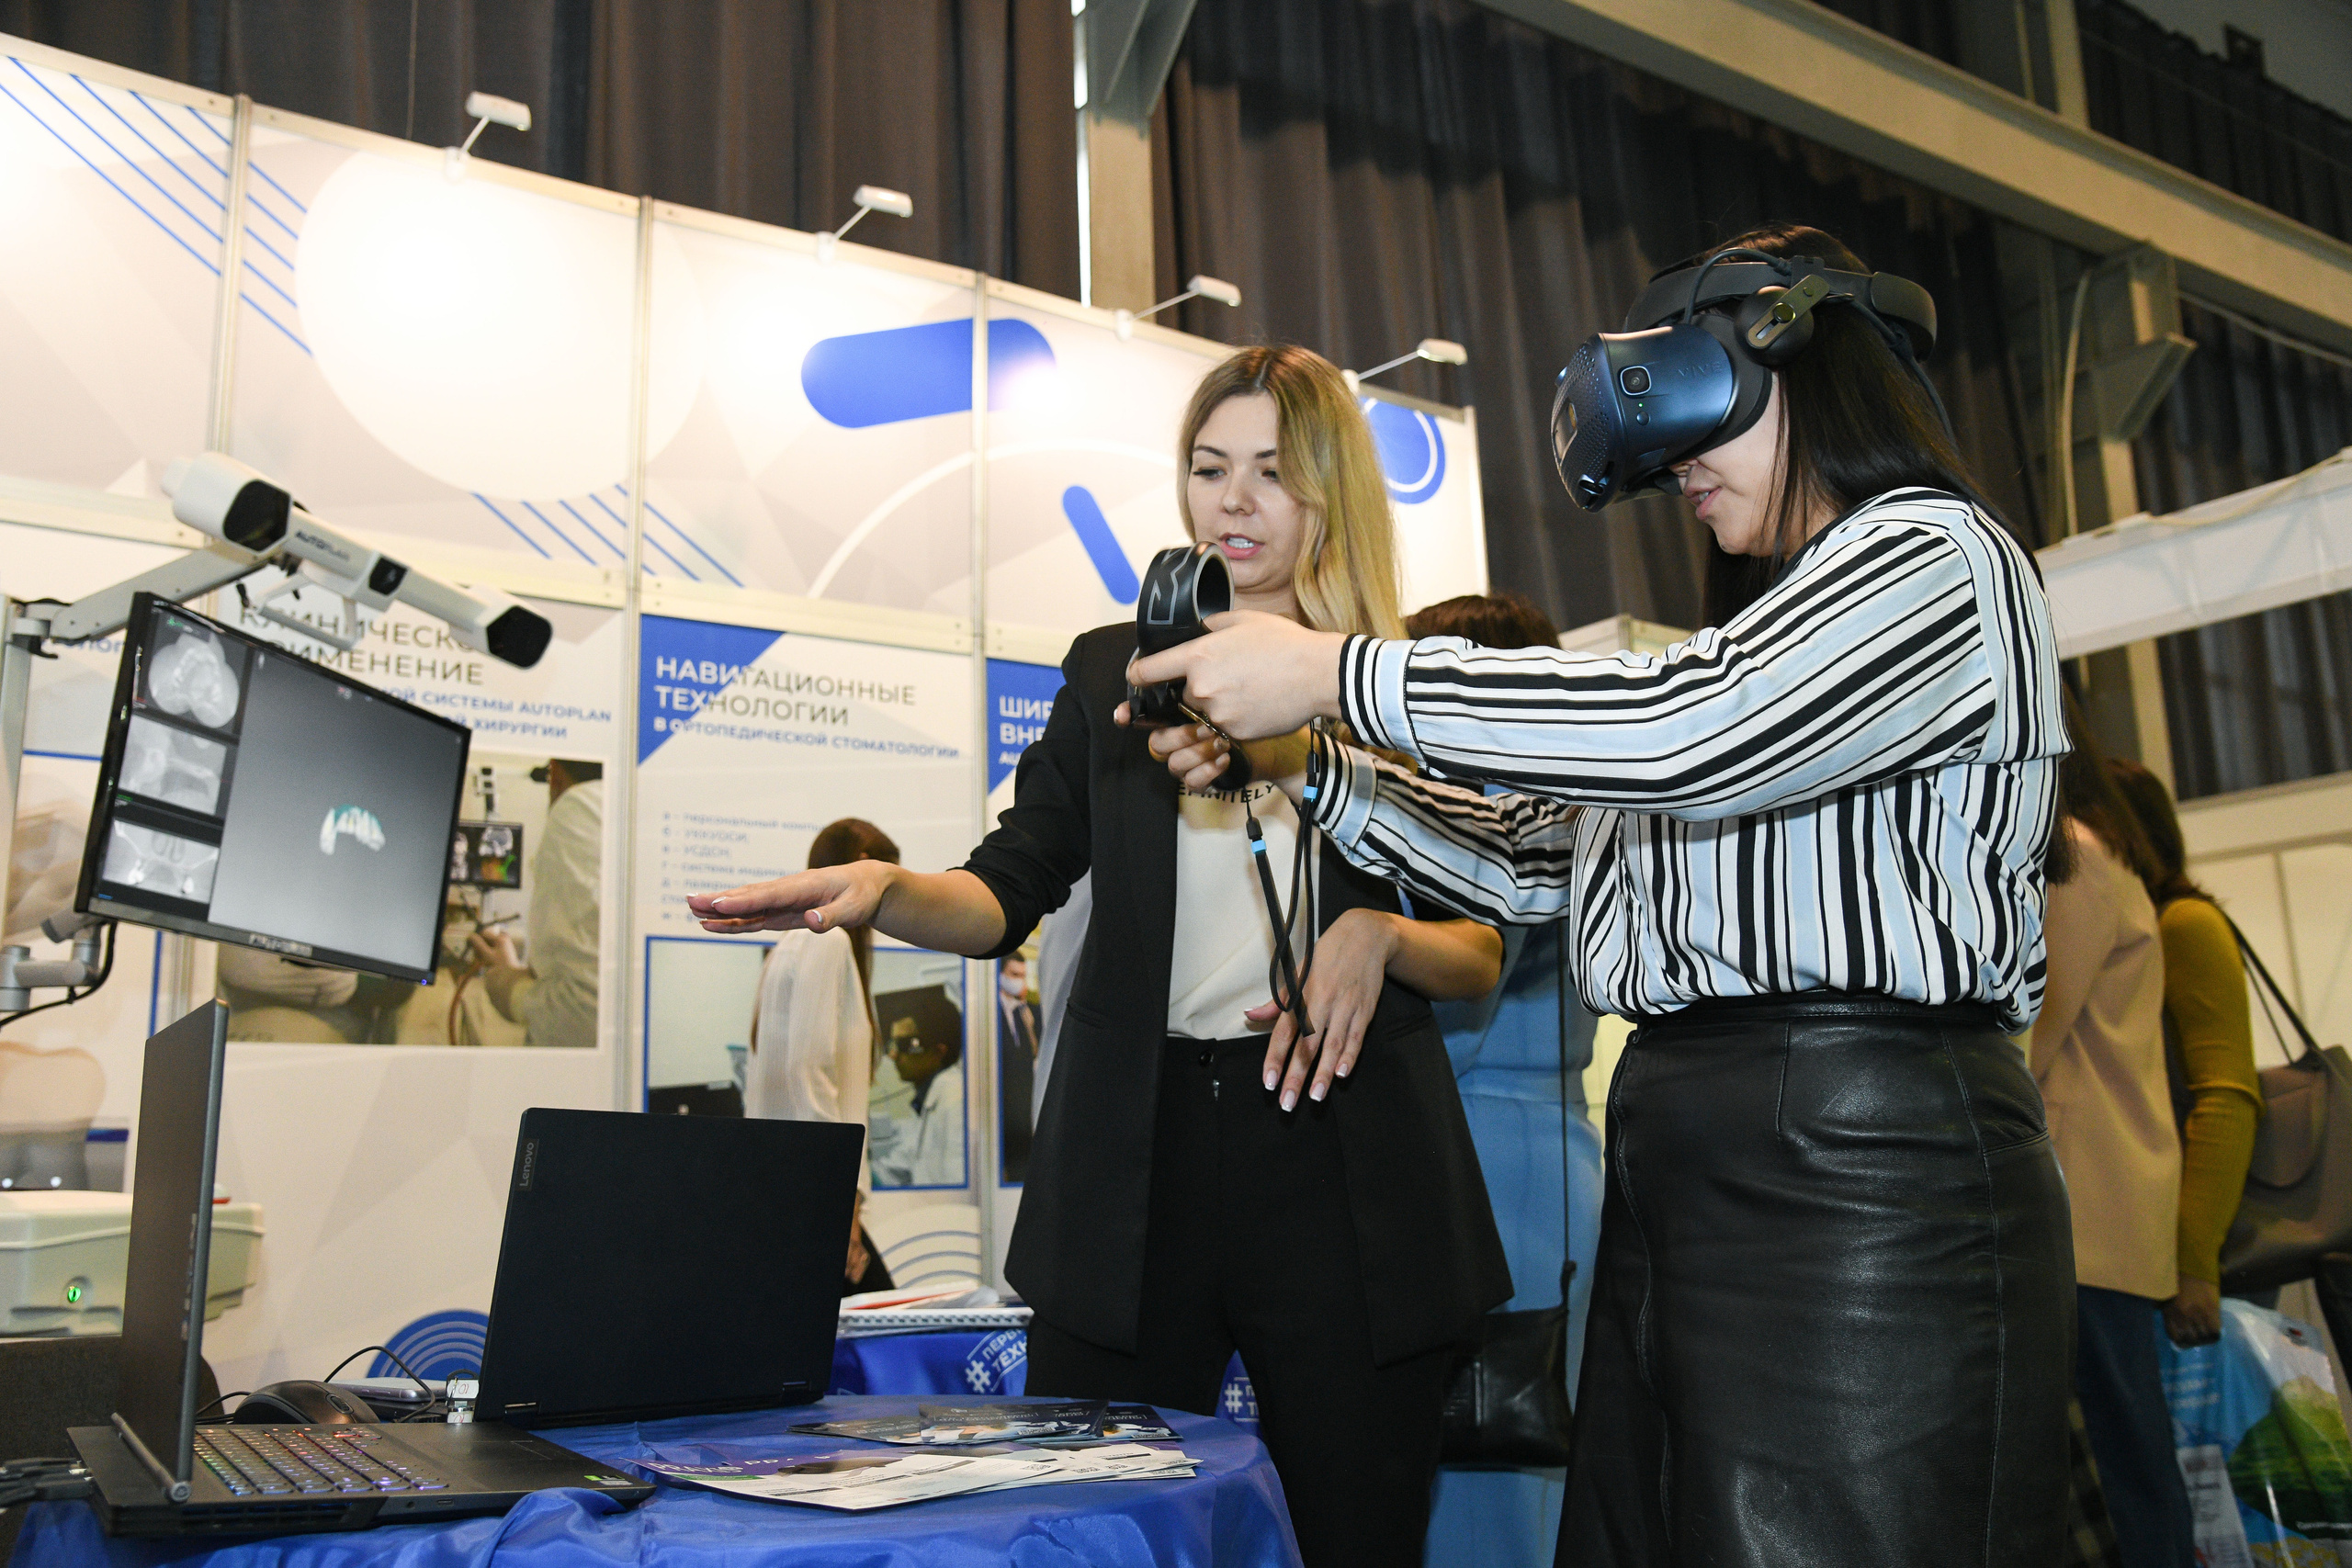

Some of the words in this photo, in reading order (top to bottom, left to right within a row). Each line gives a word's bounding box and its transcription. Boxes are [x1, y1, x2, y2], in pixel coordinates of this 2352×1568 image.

[655, 655, 917, 706] НАВИГАЦИОННЫЕ
[422, 690, 514, 712] СИСТЕМЫ
[519, 701, 611, 722] AUTOPLAN
[653, 684, 849, 727] ТЕХНОЛОГИИ
[473, 717, 568, 739] ХИРУРГИИ
[653, 716, 667, 733] В
[669, 717, 827, 746] ОРТОПЕДИЧЕСКОЙ
[831, 736, 960, 759] СТОМАТОЛОГИИ
[519, 1142, 535, 1186] Lenovo
